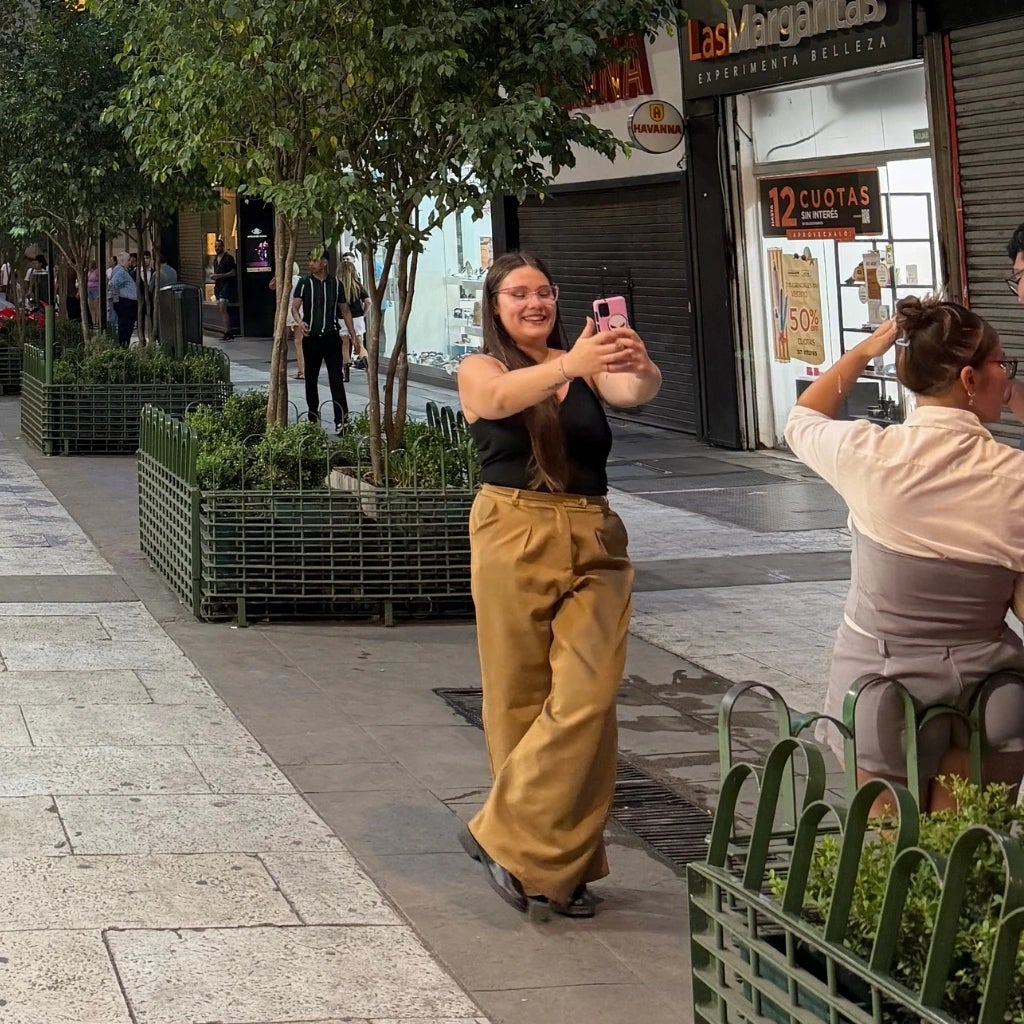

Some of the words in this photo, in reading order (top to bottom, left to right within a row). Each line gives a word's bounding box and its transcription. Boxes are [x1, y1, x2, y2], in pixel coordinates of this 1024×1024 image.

[698, 55, 799, 85] EXPERIMENTA
[811, 35, 887, 62] BELLEZA
[633, 123, 682, 135] HAVANNA
[768, 185, 798, 228] 12
[799, 185, 871, 209] CUOTAS
[800, 210, 812, 220] SIN
[812, 207, 839, 220] INTERÉS
[789, 307, 819, 332] 50%
